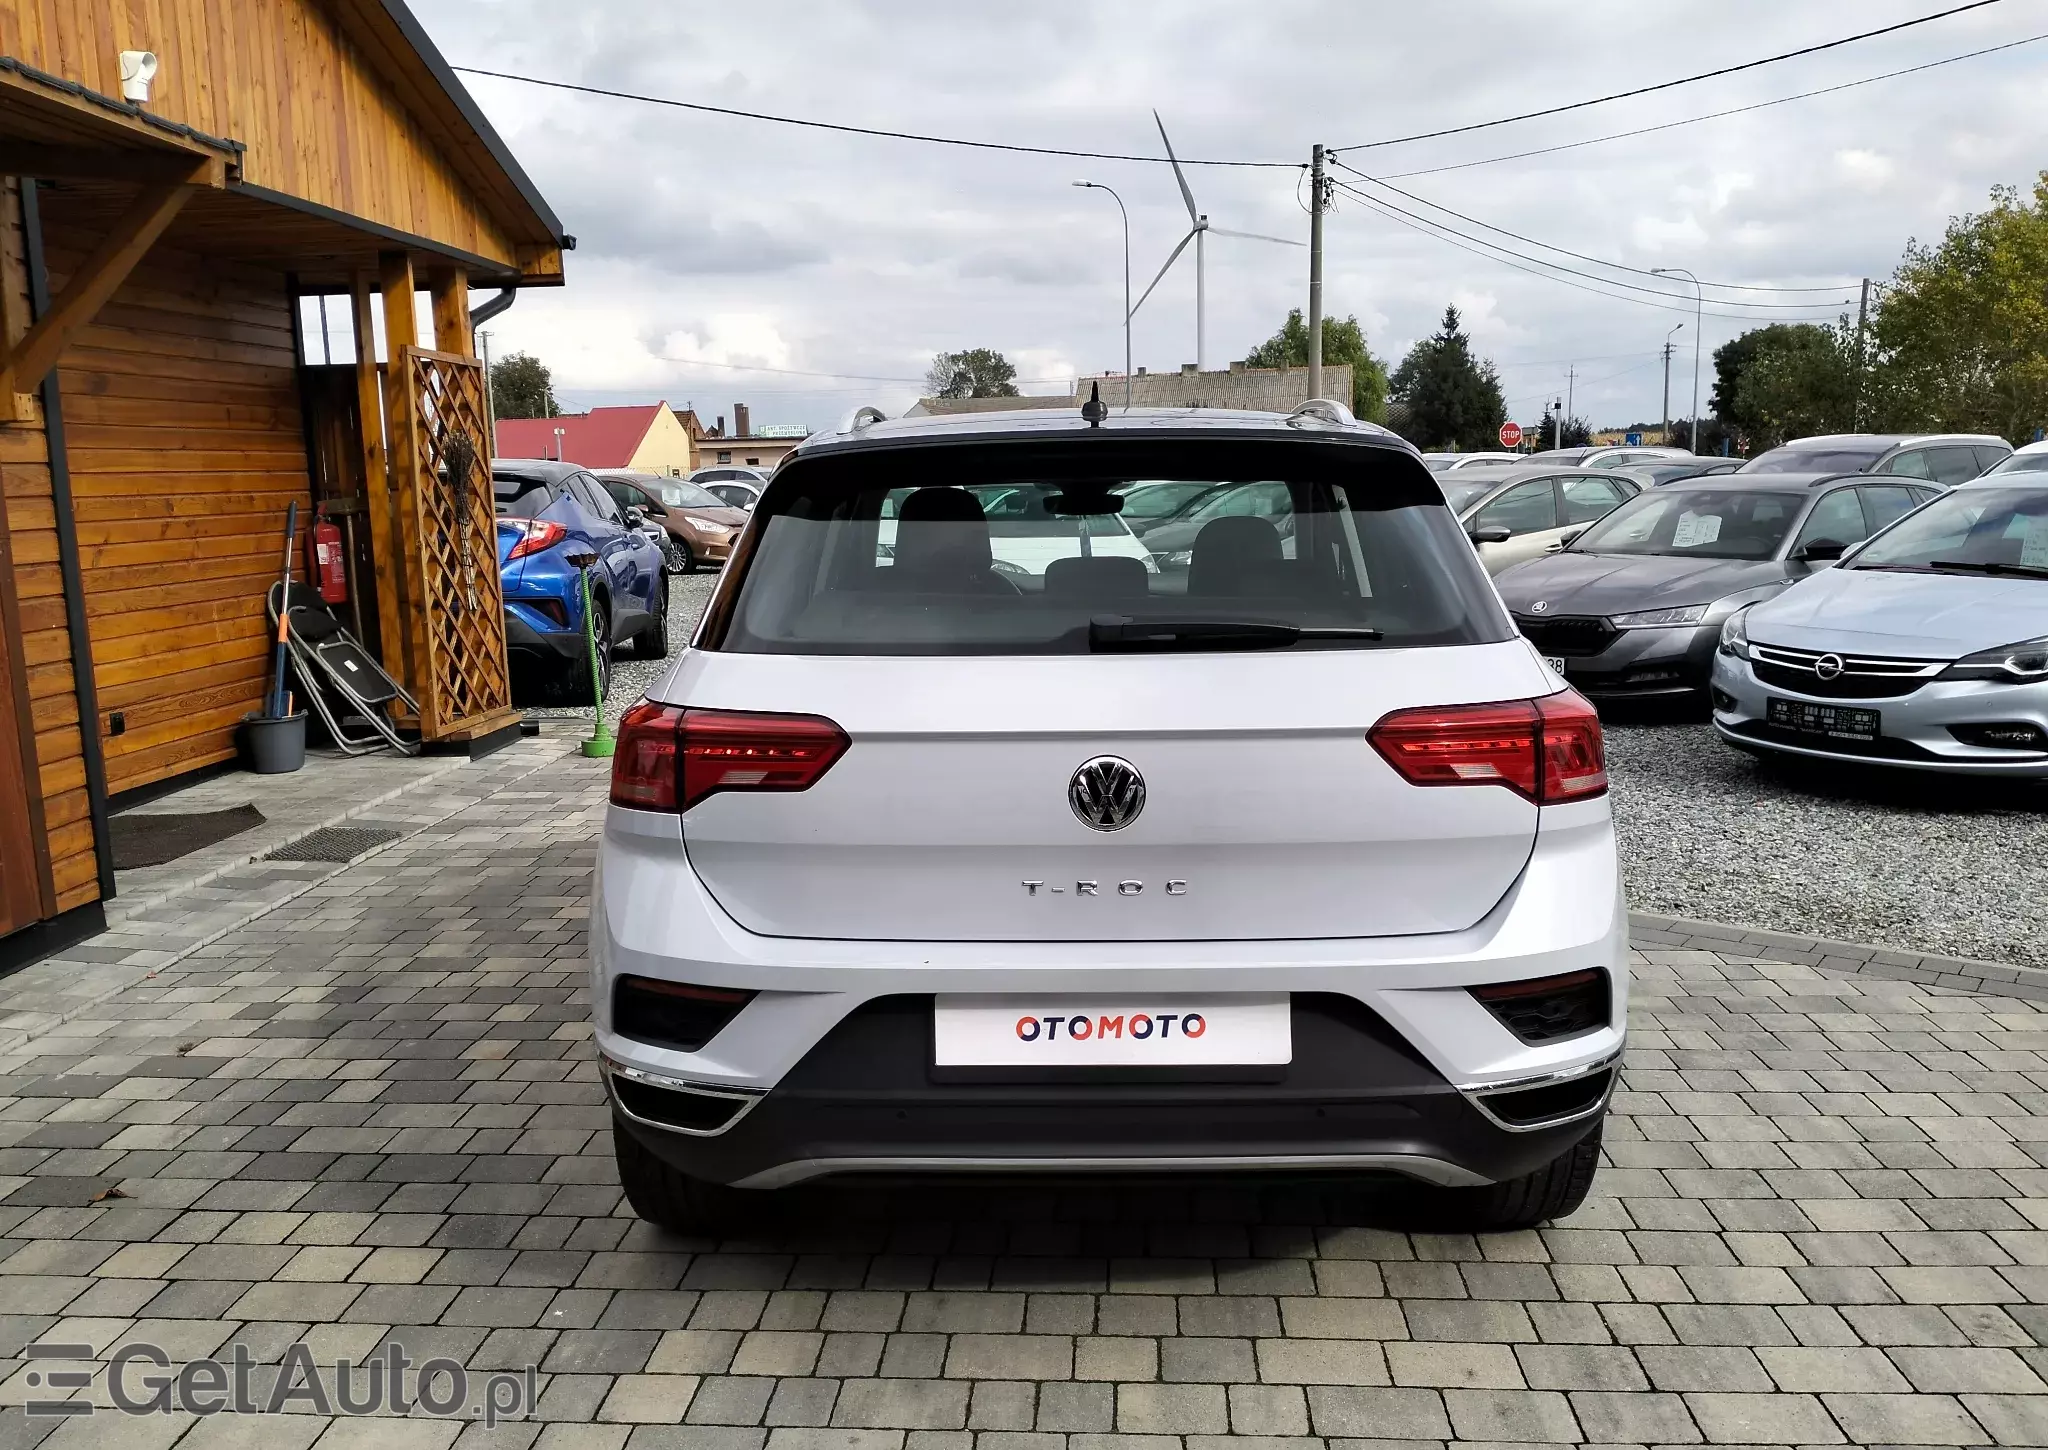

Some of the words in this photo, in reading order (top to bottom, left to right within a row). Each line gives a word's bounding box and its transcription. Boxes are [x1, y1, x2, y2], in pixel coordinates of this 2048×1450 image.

[1502, 430, 1520, 439] STOP
[1071, 757, 1144, 830] VW
[1015, 1012, 1207, 1042] OTOMOTO
